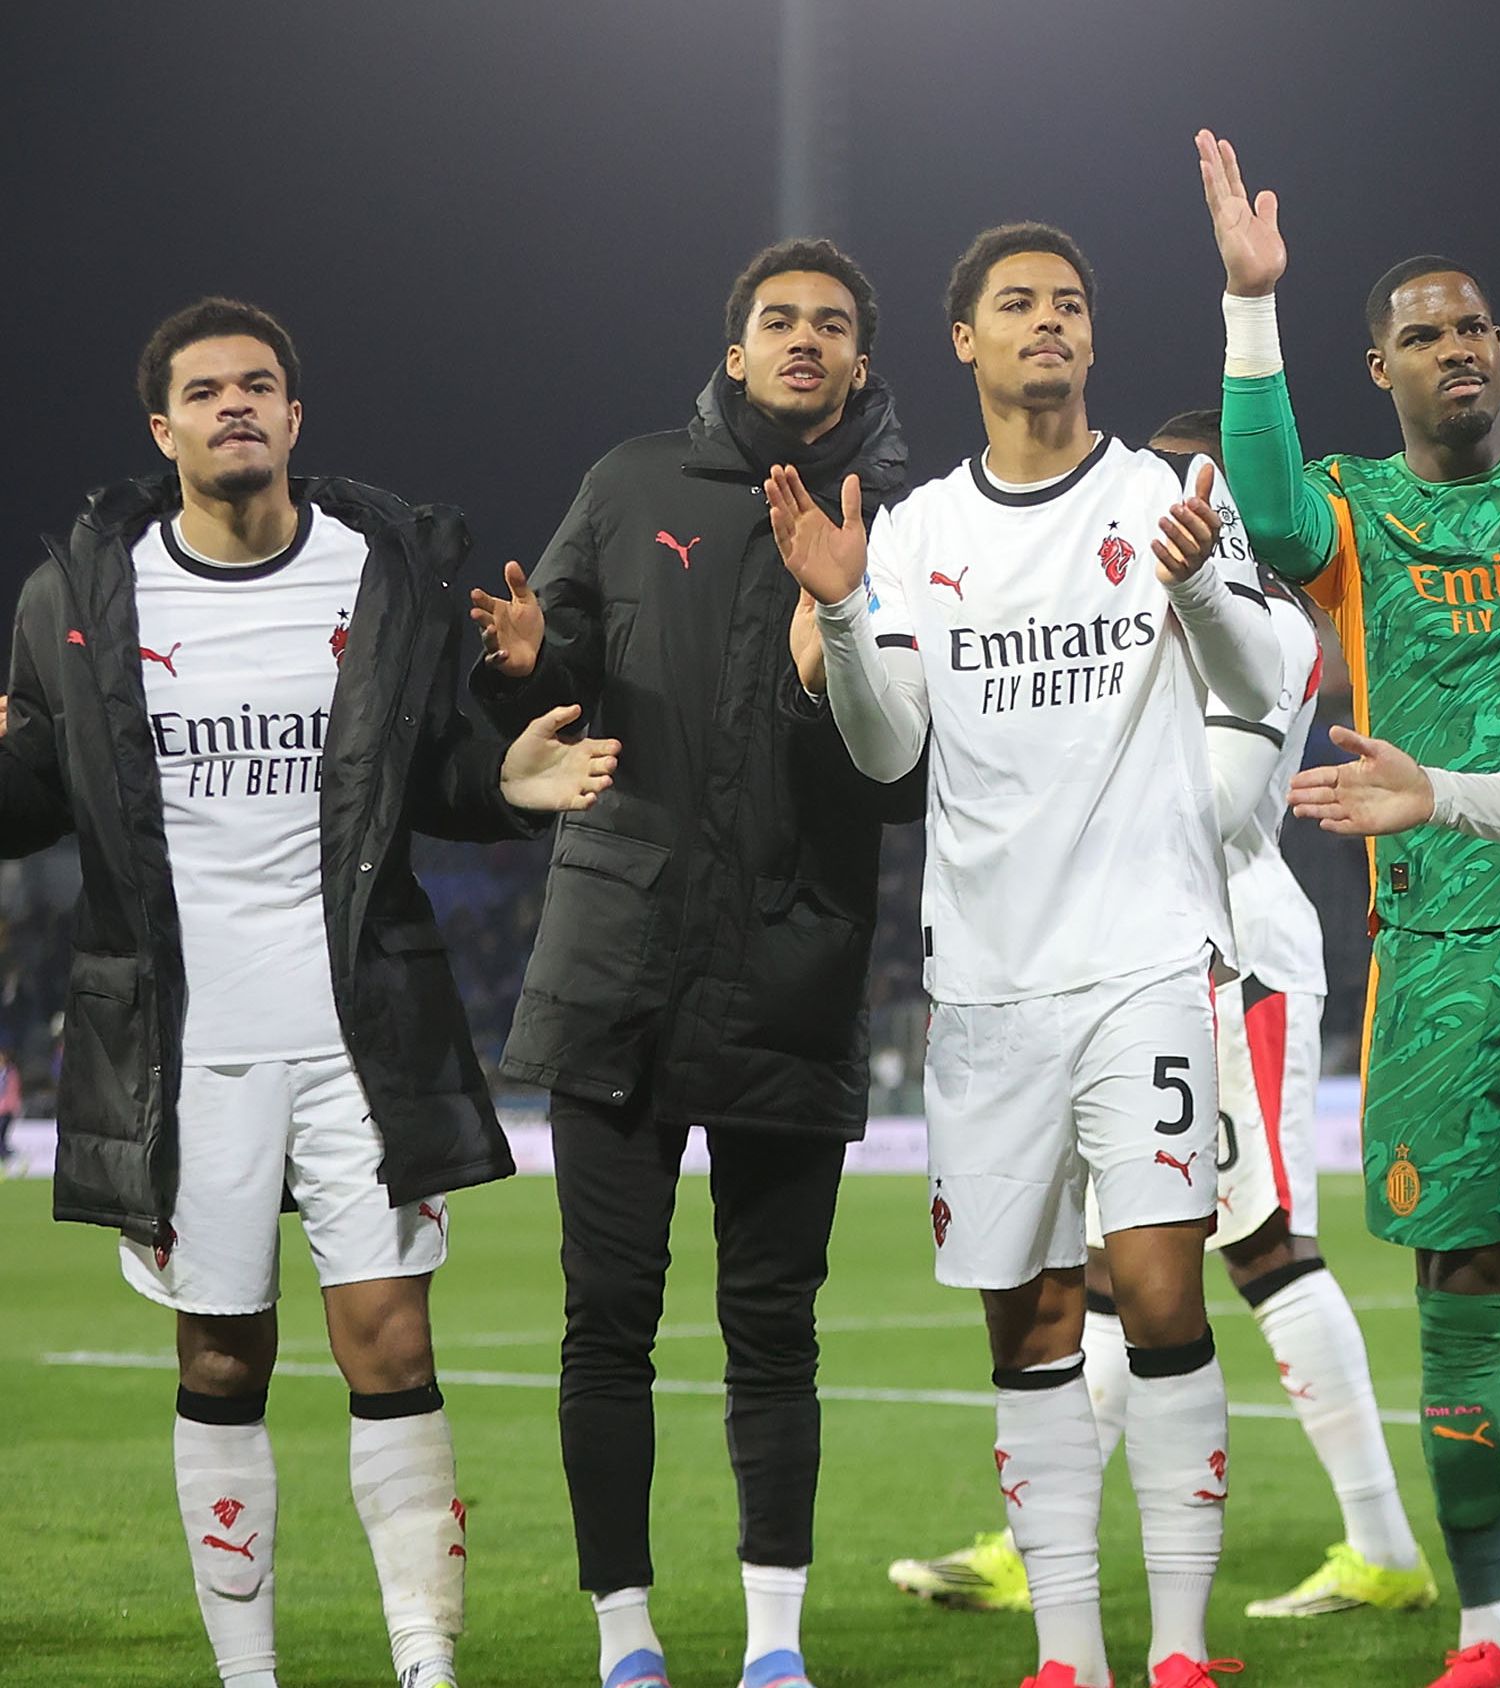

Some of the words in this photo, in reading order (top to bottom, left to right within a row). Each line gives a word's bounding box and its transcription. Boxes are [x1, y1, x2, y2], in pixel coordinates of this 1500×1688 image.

[1211, 536, 1257, 561] MS
[949, 611, 1156, 671] Emirates
[1451, 609, 1493, 635] FLY
[982, 675, 1022, 715] FLY
[1031, 661, 1124, 708] BETTER
[189, 761, 235, 798] FLY
[1153, 1056, 1194, 1135] 5
